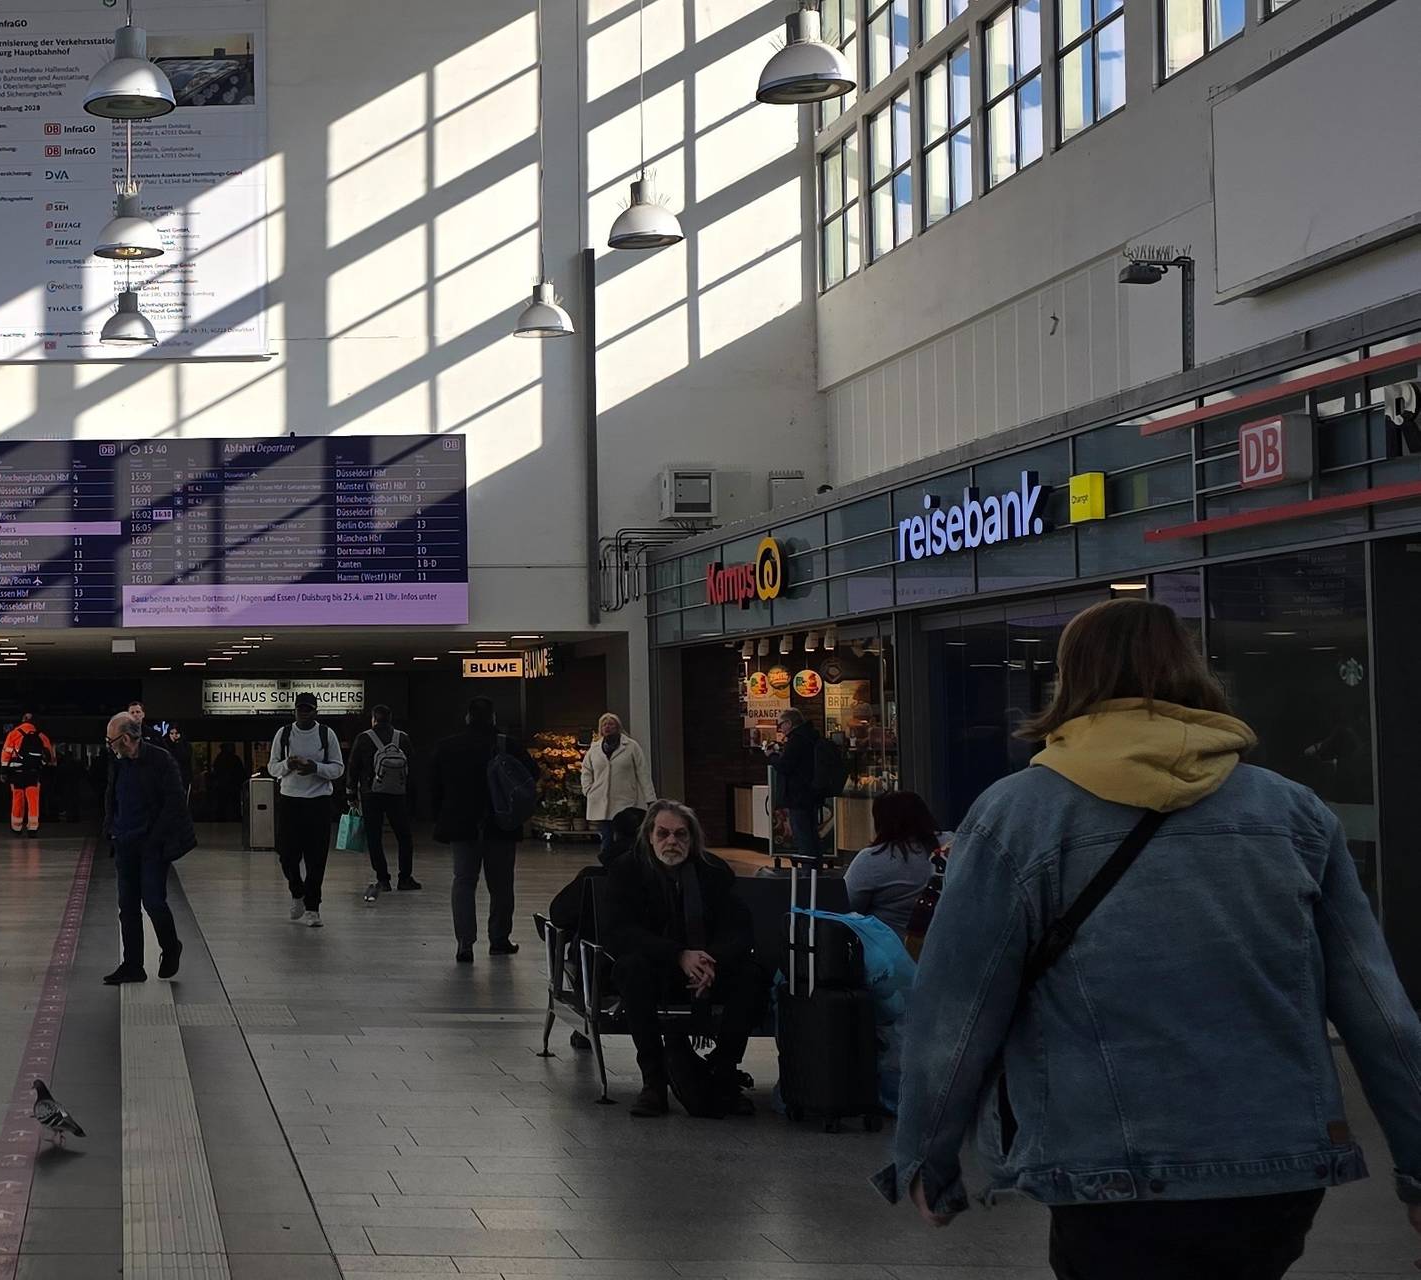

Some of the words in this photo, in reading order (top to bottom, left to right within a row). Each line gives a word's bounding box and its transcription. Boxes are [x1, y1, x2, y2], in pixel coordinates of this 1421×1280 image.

[14, 47, 70, 56] Hauptbahnhof
[64, 125, 95, 133] InfraGO
[64, 147, 96, 155] InfraGO
[45, 170, 69, 180] DVA
[224, 444, 255, 453] Abfahrt
[256, 443, 296, 454] Departure
[1246, 427, 1280, 477] DB
[73, 473, 78, 481] 4
[336, 469, 373, 477] Düsseldorf
[373, 469, 387, 477] Hbf
[416, 468, 421, 476] 2
[32, 486, 45, 494] Hbf
[73, 486, 78, 494] 4
[336, 482, 364, 491] Münster
[393, 481, 407, 489] Hbf
[416, 481, 426, 490] 10
[23, 499, 36, 507] Hbf
[73, 498, 78, 507] 2
[399, 494, 412, 502] Hbf
[131, 510, 152, 519] 16:02
[336, 508, 373, 516] Düsseldorf
[373, 507, 387, 516] Hbf
[416, 507, 422, 515] 4
[131, 523, 152, 532] 16:05
[336, 521, 357, 529] Berlin
[358, 520, 398, 529] Ostbahnhof
[417, 520, 426, 529] 13
[74, 537, 82, 546] 11
[131, 536, 152, 545] 16:07
[336, 534, 368, 542] München
[368, 534, 382, 542] Hbf
[417, 533, 422, 542] 3
[74, 550, 82, 559] 11
[131, 549, 152, 558] 16:07
[337, 547, 371, 555] Dortmund
[372, 546, 385, 555] Hbf
[417, 546, 427, 555] 10
[27, 563, 40, 572] Hbf
[74, 563, 82, 571] 12
[337, 560, 361, 568] Xanten
[74, 576, 79, 584] 3
[131, 575, 152, 584] 16:10
[337, 573, 359, 581] Hamm
[360, 573, 388, 582] (Westf)
[388, 572, 402, 581] Hbf
[418, 572, 426, 580] 11
[706, 562, 756, 607] Kamps
[16, 589, 29, 598] Hbf
[74, 589, 83, 597] 13
[131, 594, 171, 603] Bauarbeiten
[171, 594, 201, 602] zwischen
[202, 594, 235, 602] Dortmund
[240, 593, 262, 603] Hagen
[263, 593, 276, 602] und
[277, 593, 296, 602] Essen
[301, 593, 331, 603] Duisburg
[331, 593, 342, 601] bis
[343, 593, 362, 601] 25.4.
[375, 593, 383, 601] 21
[400, 592, 418, 601] Infos
[418, 593, 437, 601] unter
[32, 602, 45, 610] Hbf
[74, 601, 79, 610] 2
[26, 615, 39, 623] Hbf
[73, 615, 79, 623] 4
[470, 663, 517, 673] BLUME
[204, 691, 266, 703] LEIHHAUS
[270, 691, 363, 703] SCHACHERS
[748, 709, 781, 719] ORANGE
